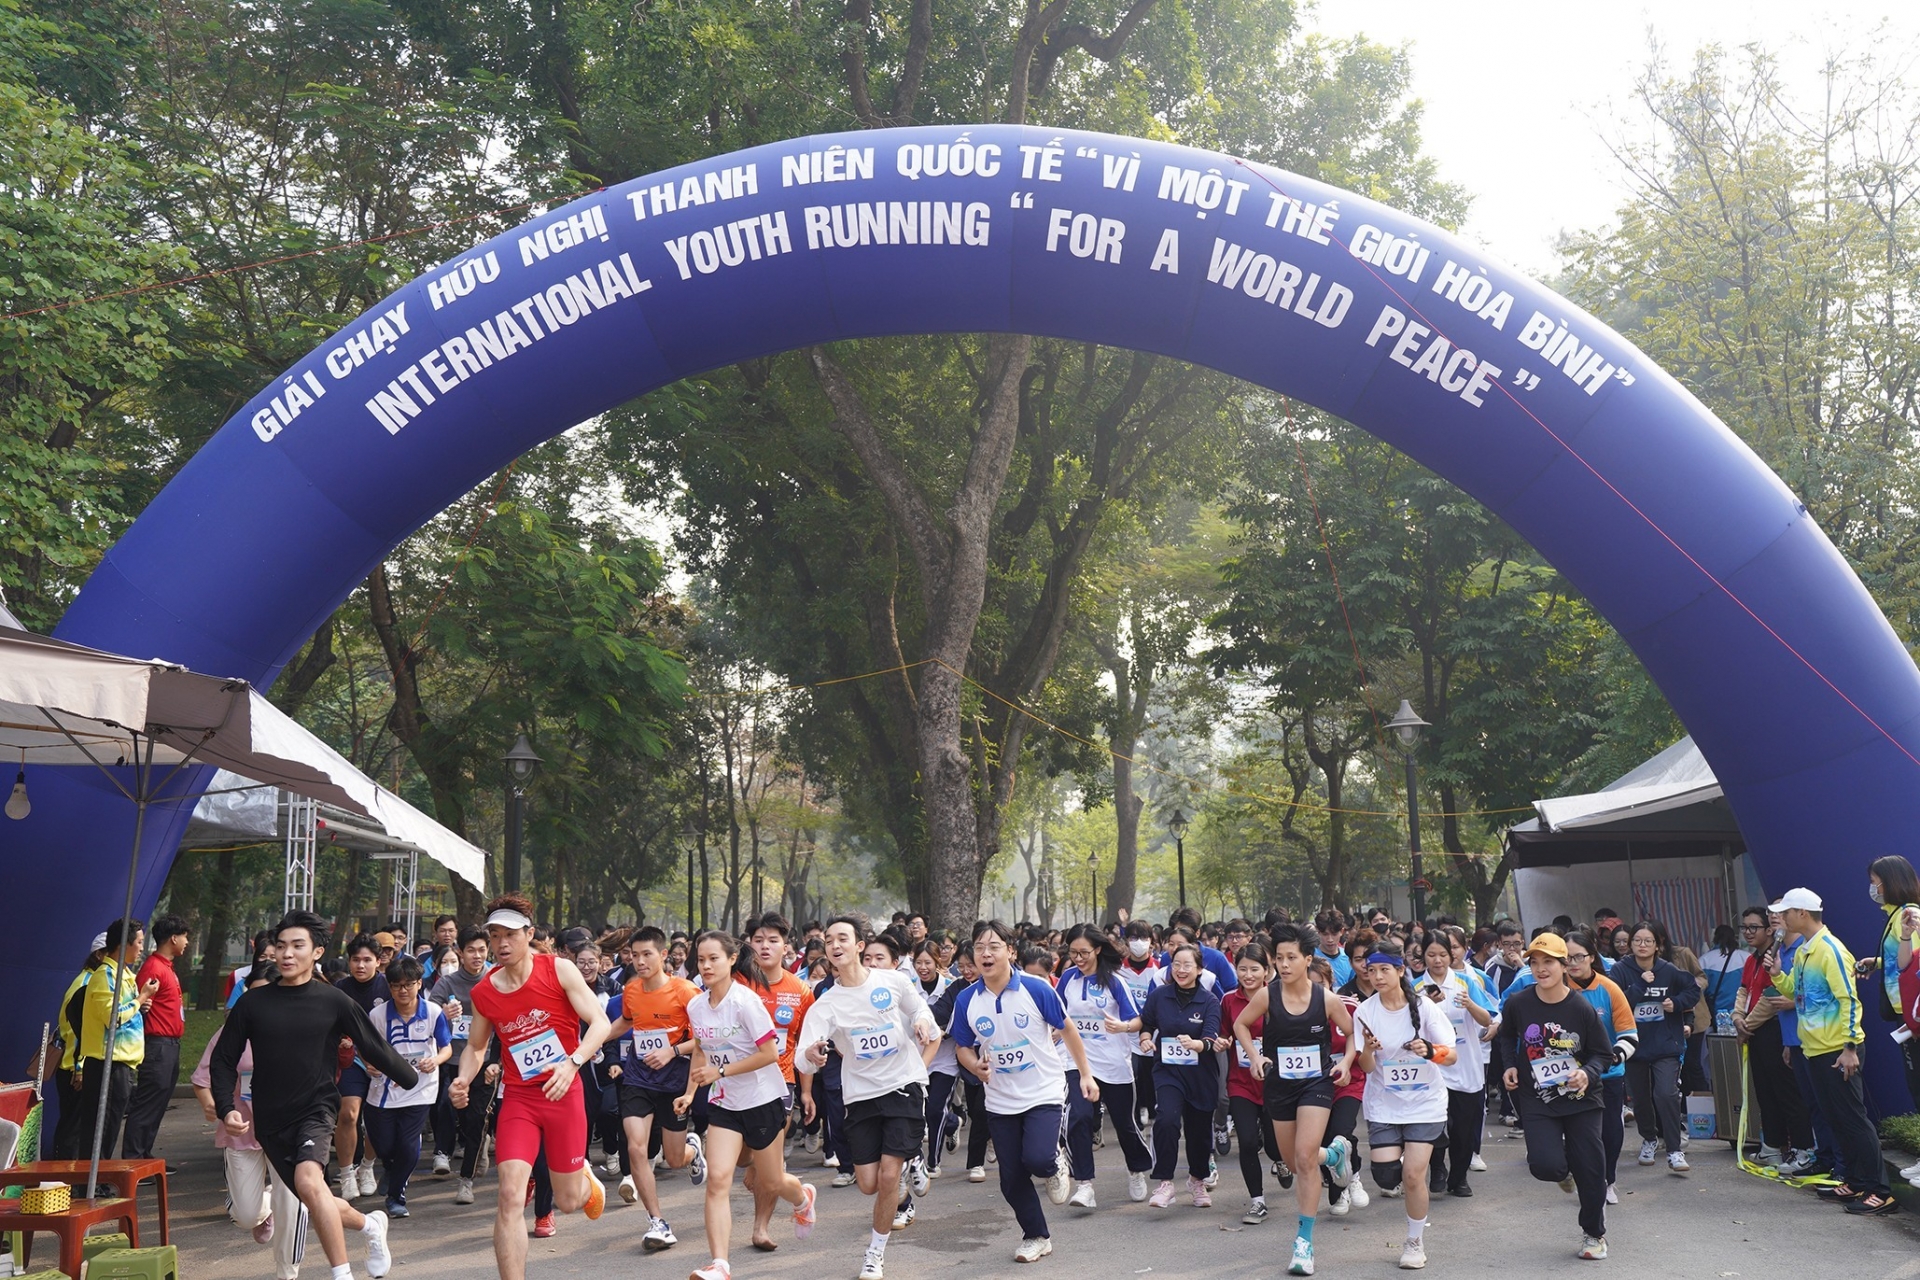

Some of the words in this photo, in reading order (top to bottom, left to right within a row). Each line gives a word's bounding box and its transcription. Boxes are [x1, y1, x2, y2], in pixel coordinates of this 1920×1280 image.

[250, 370, 327, 443] GIẢI
[325, 302, 413, 380] CHẠY
[427, 250, 501, 310] HỮU
[518, 205, 611, 268] NGHỊ
[627, 163, 758, 221] THANH
[781, 145, 875, 187] NIÊN
[897, 132, 1001, 181] QUỐC
[1157, 168, 1250, 220] MỘT
[1265, 191, 1341, 247] THẾ
[1348, 224, 1431, 284] GIỚI
[1431, 259, 1515, 331] HÒA
[364, 252, 652, 436] INTERNATIONAL
[663, 210, 793, 281] YOUTH
[804, 201, 990, 250] RUNNING
[1045, 207, 1127, 265] FOR
[1150, 228, 1180, 274] A
[1206, 237, 1354, 329] WORLD
[1365, 304, 1503, 408] PEACE
[871, 991, 890, 1003] 360
[776, 1010, 792, 1019] 422
[1639, 1006, 1659, 1016] 506
[977, 1020, 992, 1032] 208
[1077, 1020, 1099, 1031] 346
[640, 1038, 663, 1050] 490
[860, 1034, 889, 1050] 200
[523, 1044, 555, 1066] 622
[998, 1050, 1024, 1065] 599
[1286, 1056, 1311, 1069] 321
[1541, 1061, 1570, 1077] 204
[1391, 1068, 1419, 1081] 337
